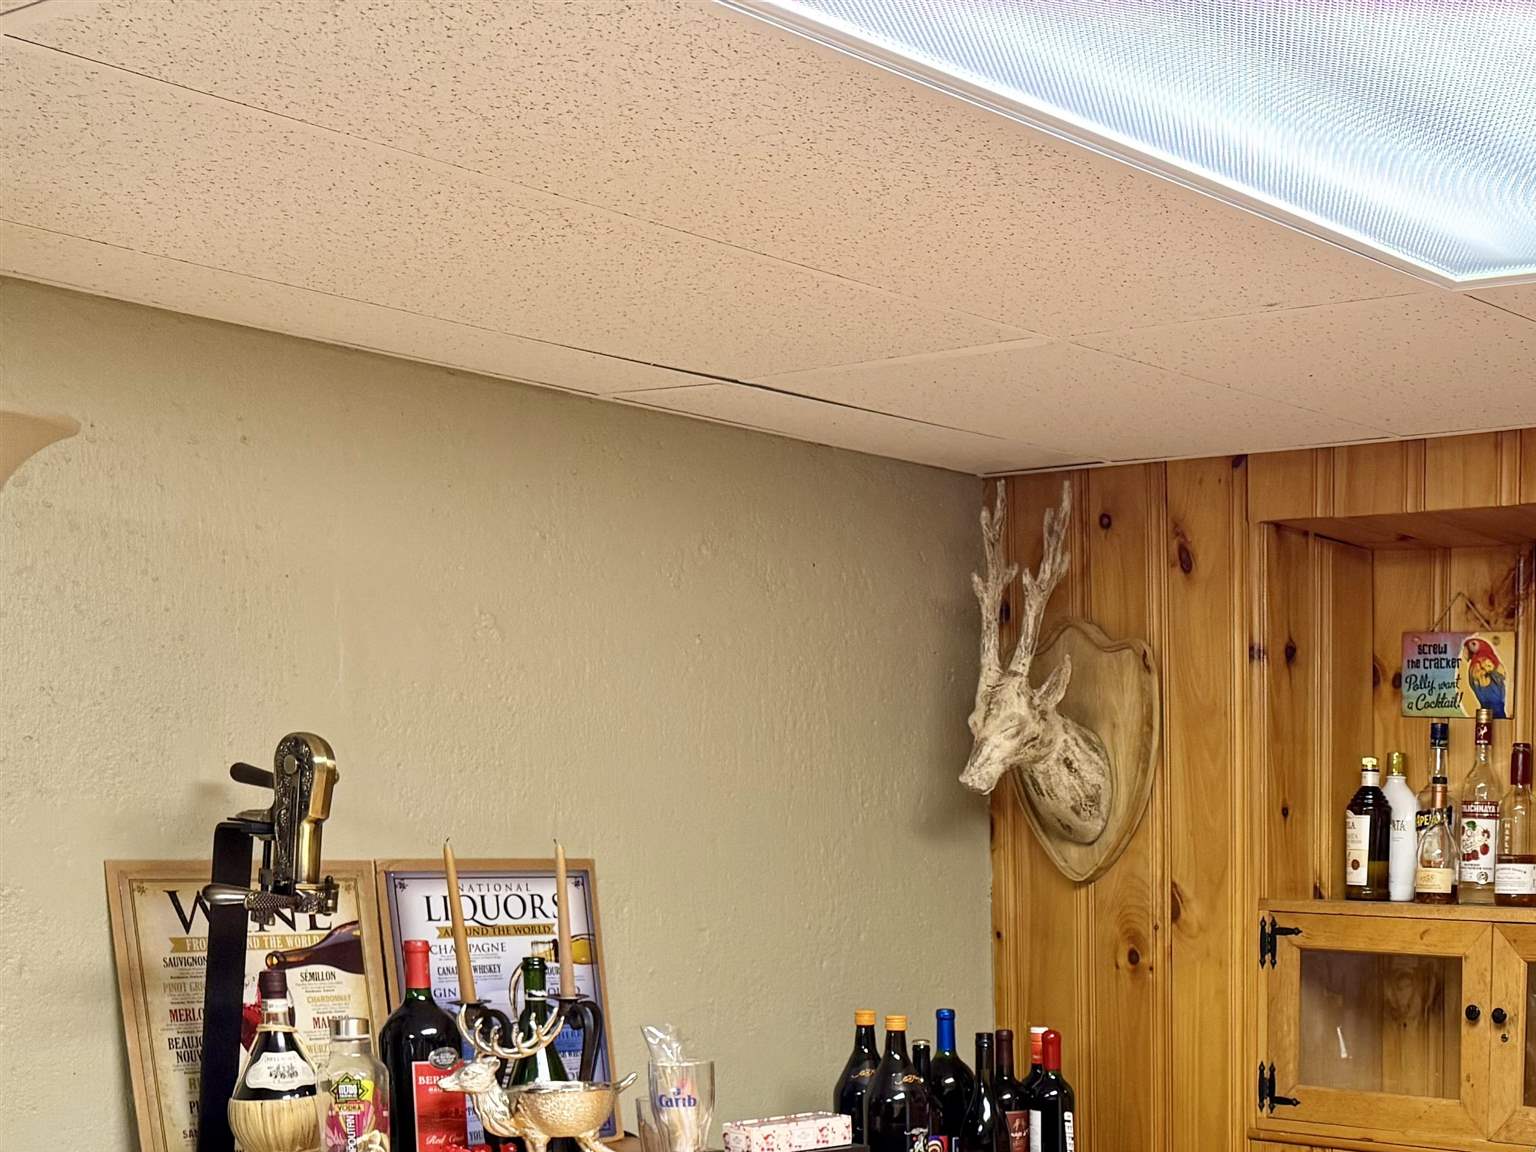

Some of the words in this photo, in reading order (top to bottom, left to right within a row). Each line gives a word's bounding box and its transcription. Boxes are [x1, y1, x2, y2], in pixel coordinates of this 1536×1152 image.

[1437, 675, 1462, 690] want
[1407, 701, 1415, 711] a
[1415, 691, 1463, 711] Cocktail!
[458, 882, 532, 893] NATIONAL
[165, 889, 333, 935] WNE
[493, 926, 510, 936] THE
[514, 924, 551, 936] WORLD
[186, 937, 208, 949] FRO
[265, 935, 282, 949] THE
[286, 934, 320, 949] WORLD
[430, 942, 507, 955] CHAPAGNE
[473, 964, 501, 975] WHISKEY
[433, 987, 457, 998] GIN
[169, 1007, 204, 1022] MERLO
[658, 1092, 697, 1108] Carib
[337, 1103, 362, 1112] VODKA
